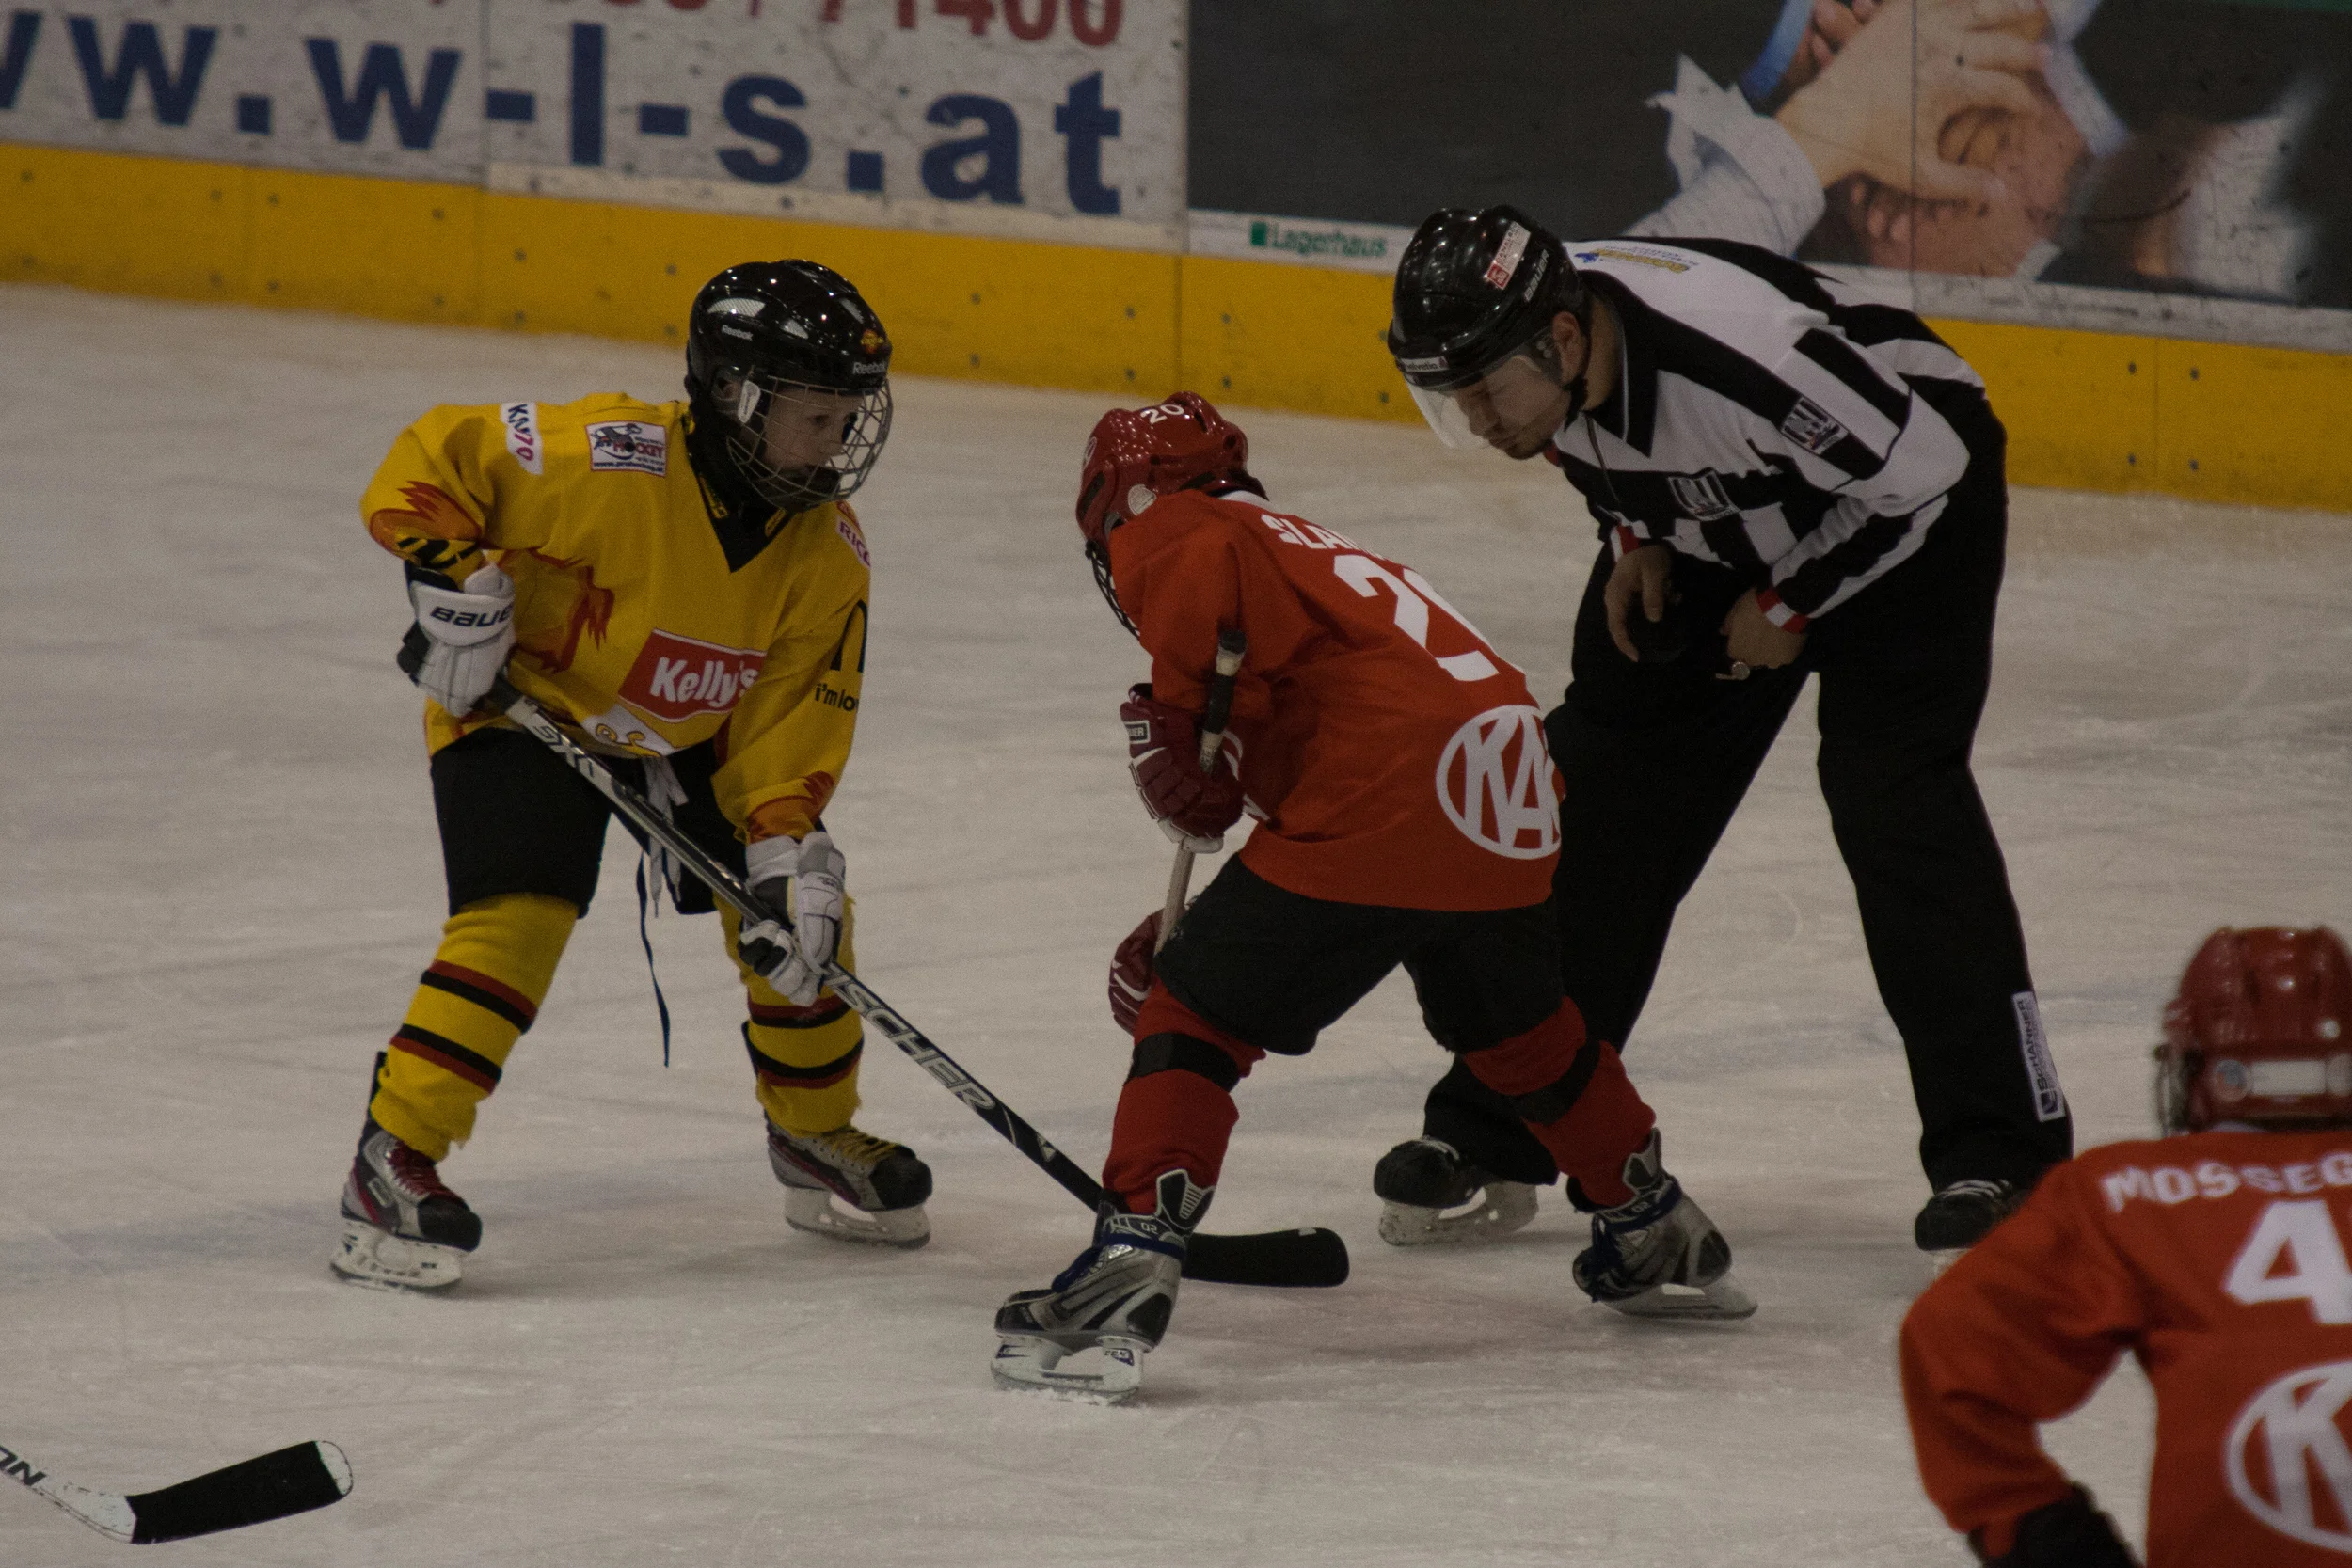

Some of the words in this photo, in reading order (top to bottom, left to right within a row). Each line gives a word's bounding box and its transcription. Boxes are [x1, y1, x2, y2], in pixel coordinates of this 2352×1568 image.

[1139, 404, 1185, 424] 20
[1260, 514, 1372, 553] SLA
[2221, 1199, 2352, 1325] 4
